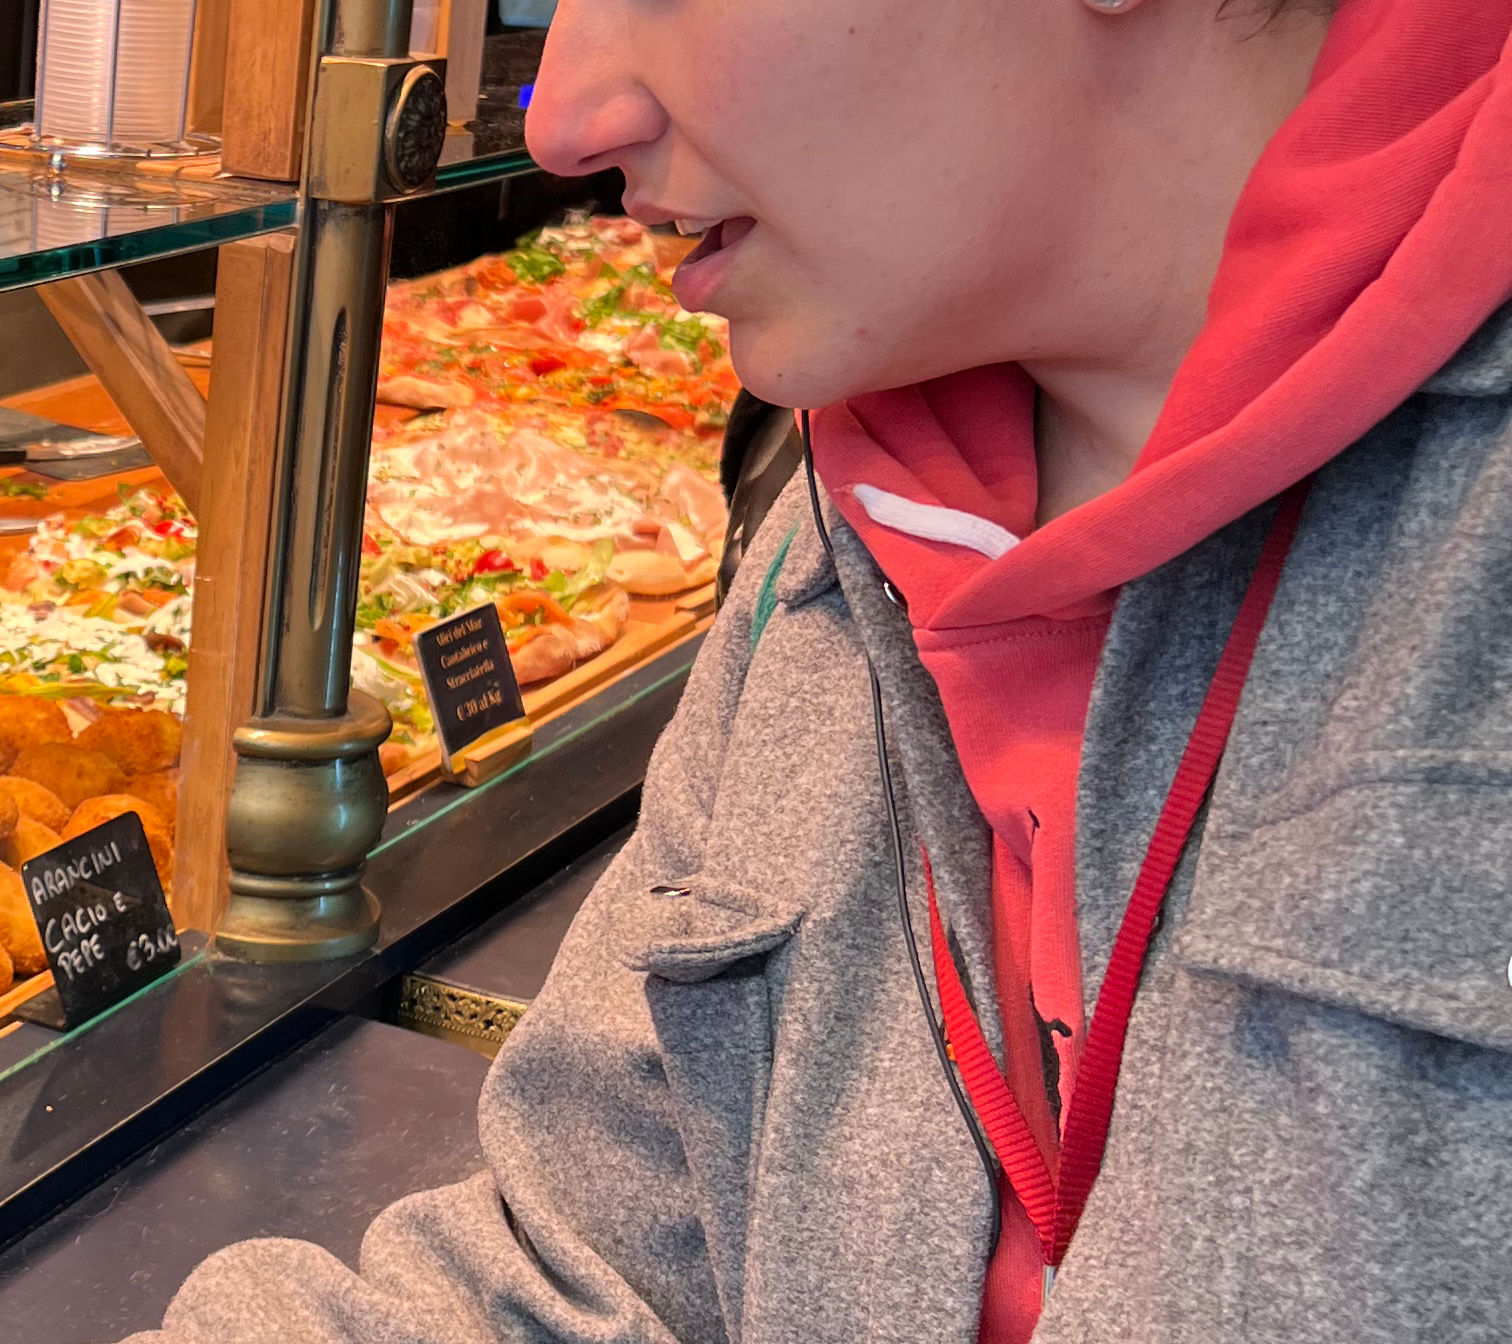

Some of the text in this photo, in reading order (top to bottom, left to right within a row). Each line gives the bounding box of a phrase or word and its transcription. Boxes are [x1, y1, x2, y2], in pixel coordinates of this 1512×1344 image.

[31, 840, 123, 906] ARANCINI
[44, 891, 127, 954] CACIO E
[56, 932, 105, 982] PEPE
